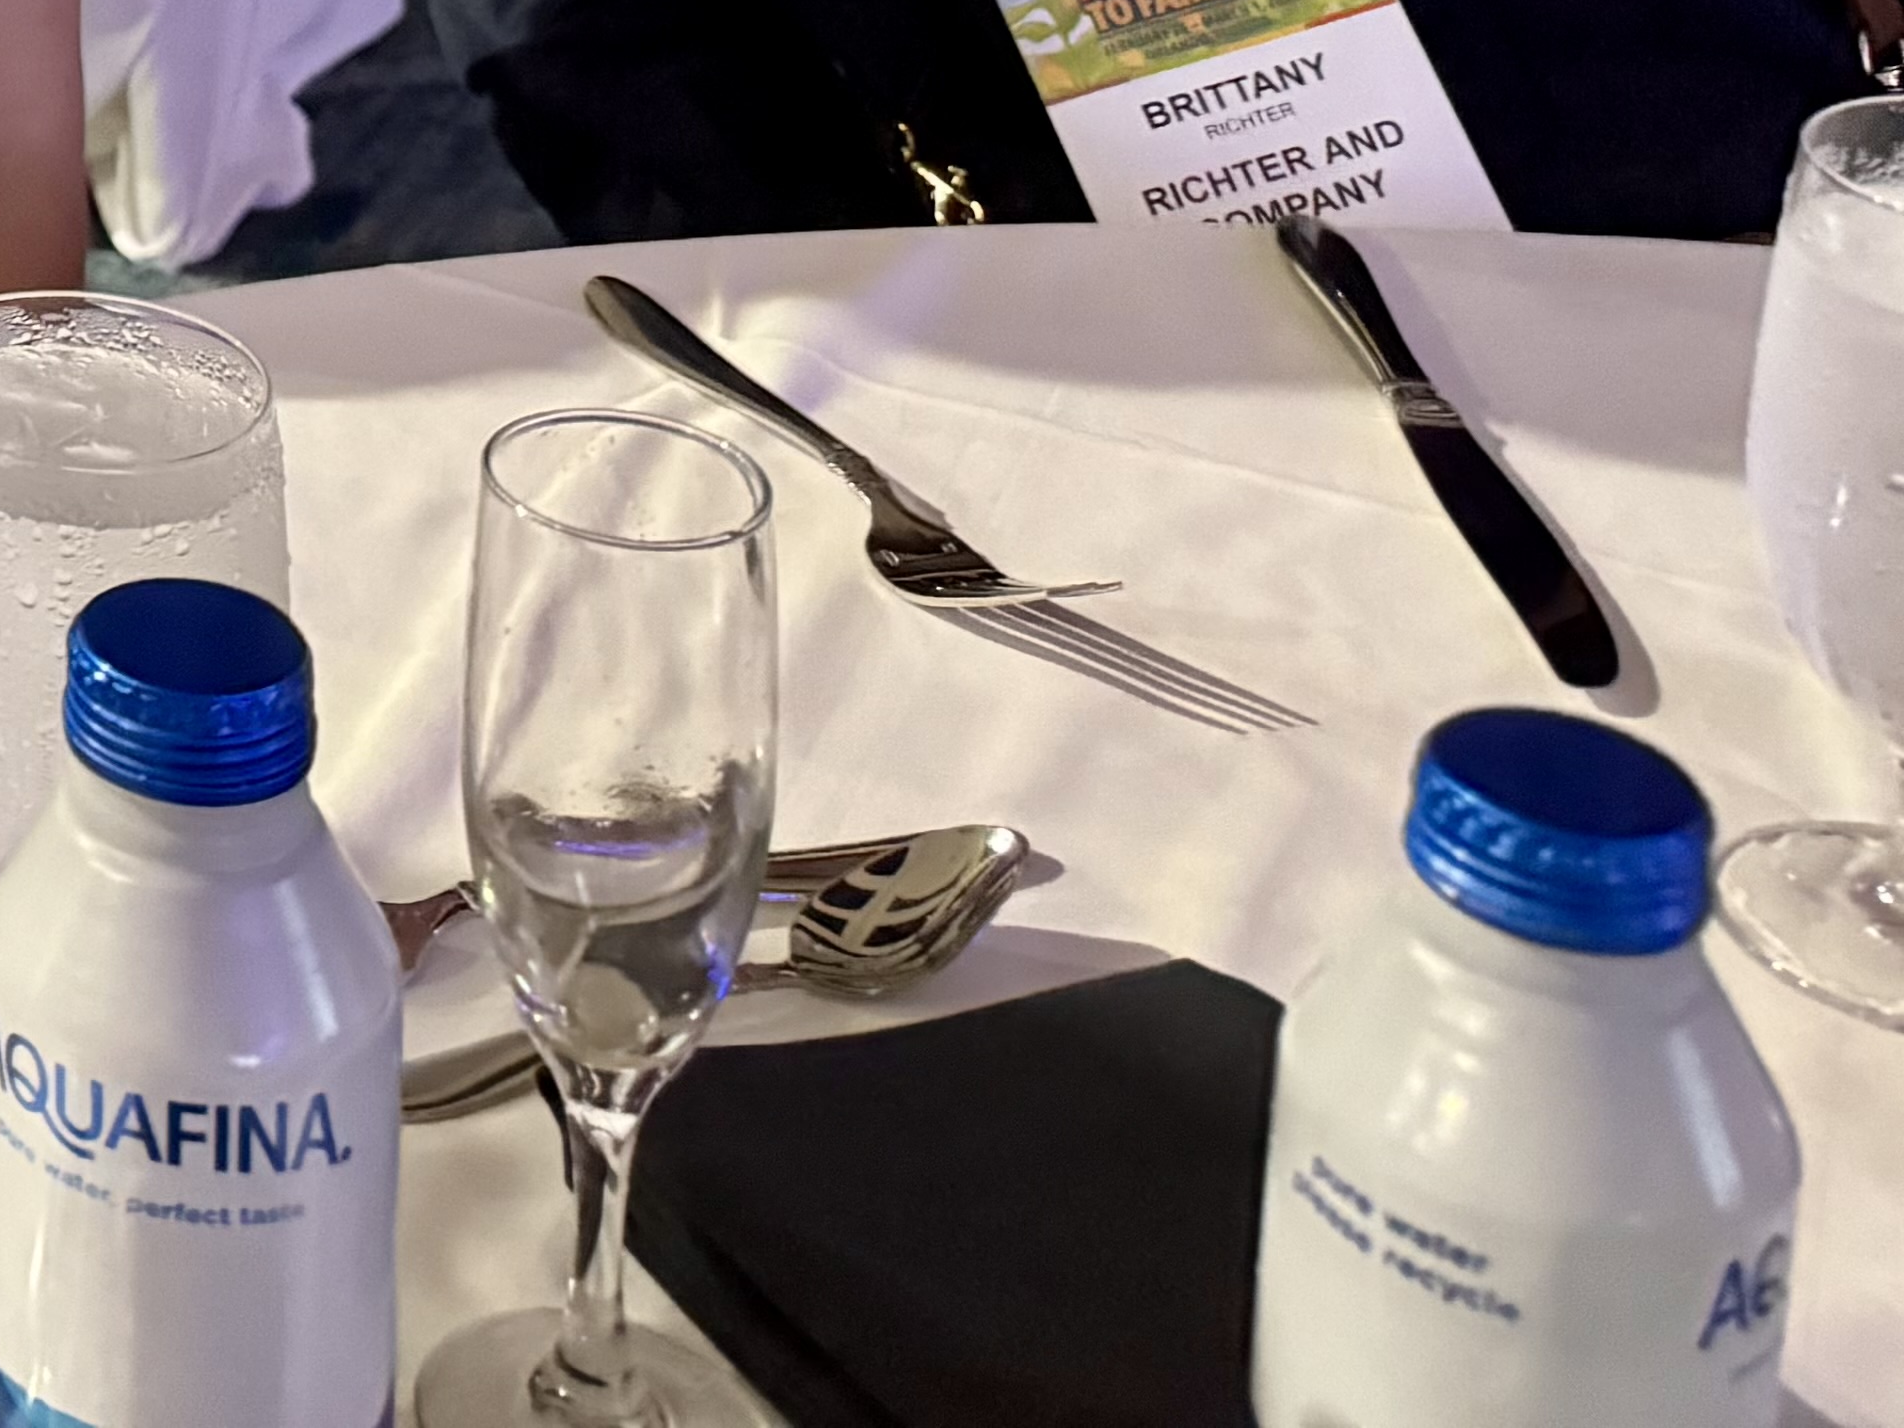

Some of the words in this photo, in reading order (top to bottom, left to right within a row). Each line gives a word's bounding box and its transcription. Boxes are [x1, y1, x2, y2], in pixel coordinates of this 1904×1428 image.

[1141, 52, 1326, 130] BRITTANY
[1204, 101, 1297, 141] RICHTER
[1142, 145, 1316, 217] RICHTER
[1324, 120, 1405, 166] AND
[1202, 168, 1387, 226] MPANY
[126, 1196, 233, 1227] perfect
